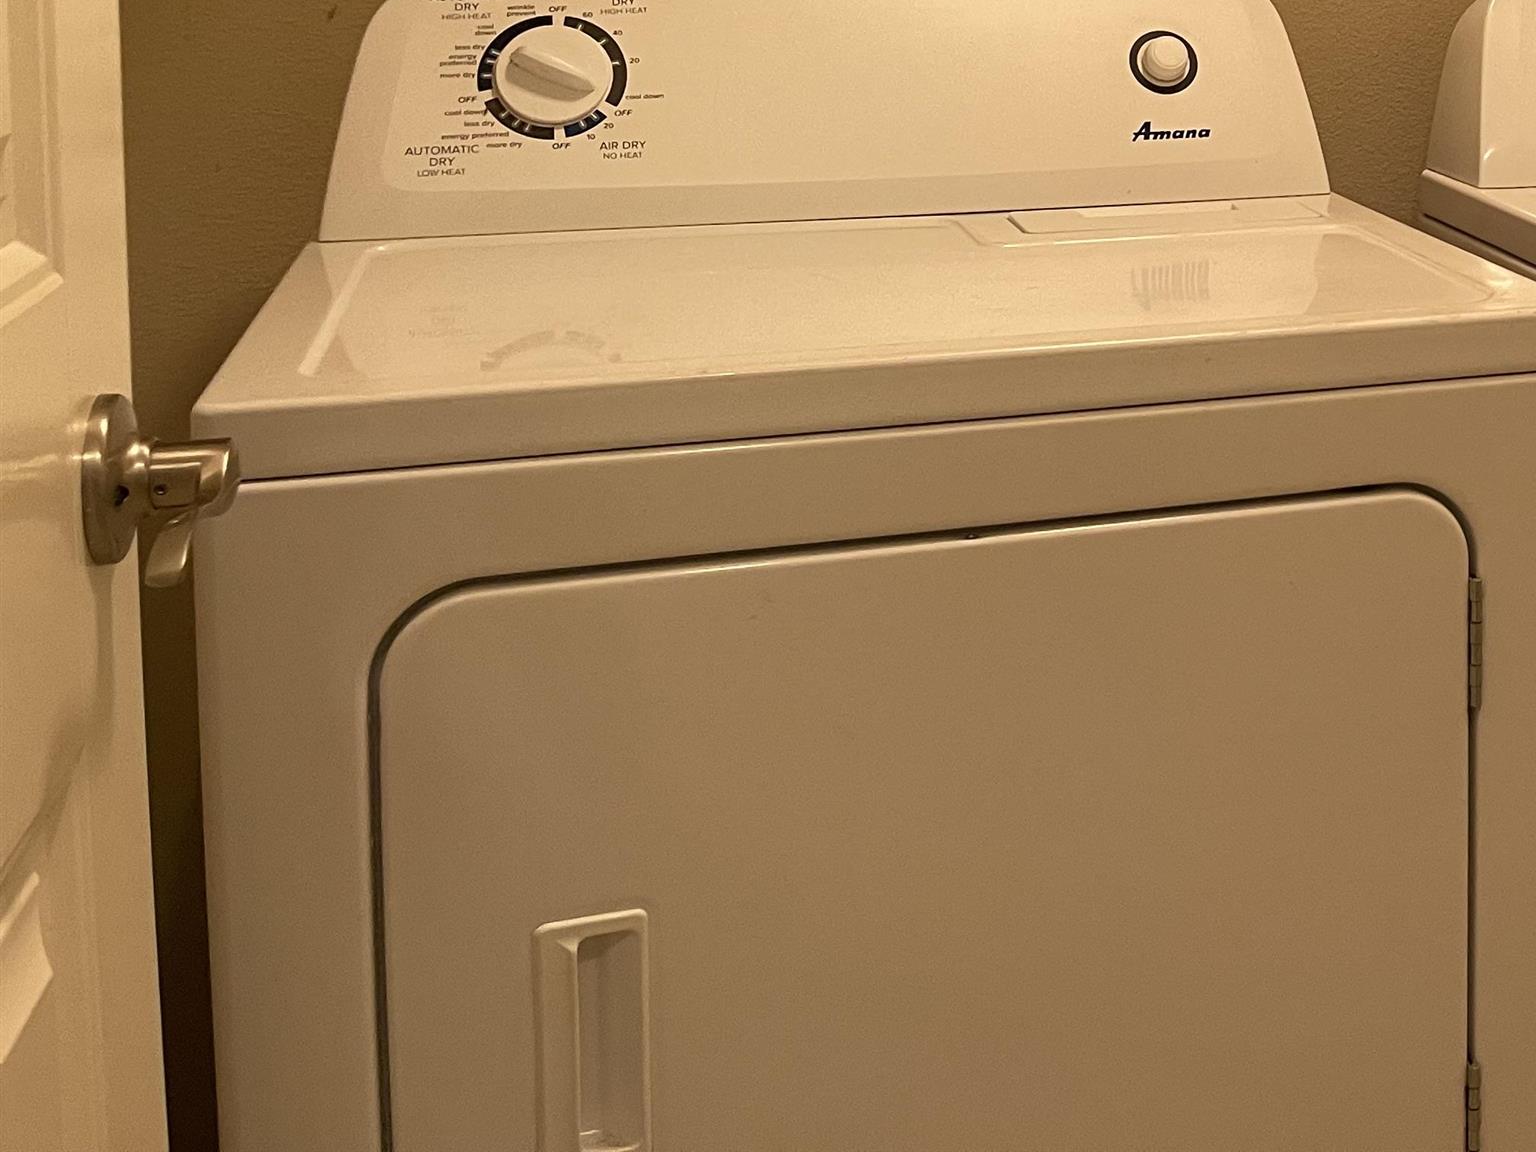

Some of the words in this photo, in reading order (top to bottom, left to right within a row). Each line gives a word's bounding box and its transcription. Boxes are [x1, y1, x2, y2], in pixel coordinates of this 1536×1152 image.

[454, 2, 479, 11] DRY
[548, 5, 567, 13] OFF
[467, 12, 491, 20] HEAT
[462, 72, 476, 80] dry
[457, 95, 477, 104] OFF
[614, 109, 633, 117] OFF
[1131, 120, 1211, 142] Amana
[552, 142, 571, 150] OFF
[599, 141, 619, 150] AIR
[622, 140, 647, 150] DRY
[404, 144, 480, 156] AUTOMATIC
[603, 152, 617, 160] NO
[619, 151, 642, 159] HEAT
[429, 157, 456, 167] DRY
[417, 169, 439, 177] LOW
[441, 168, 466, 176] HEAT
